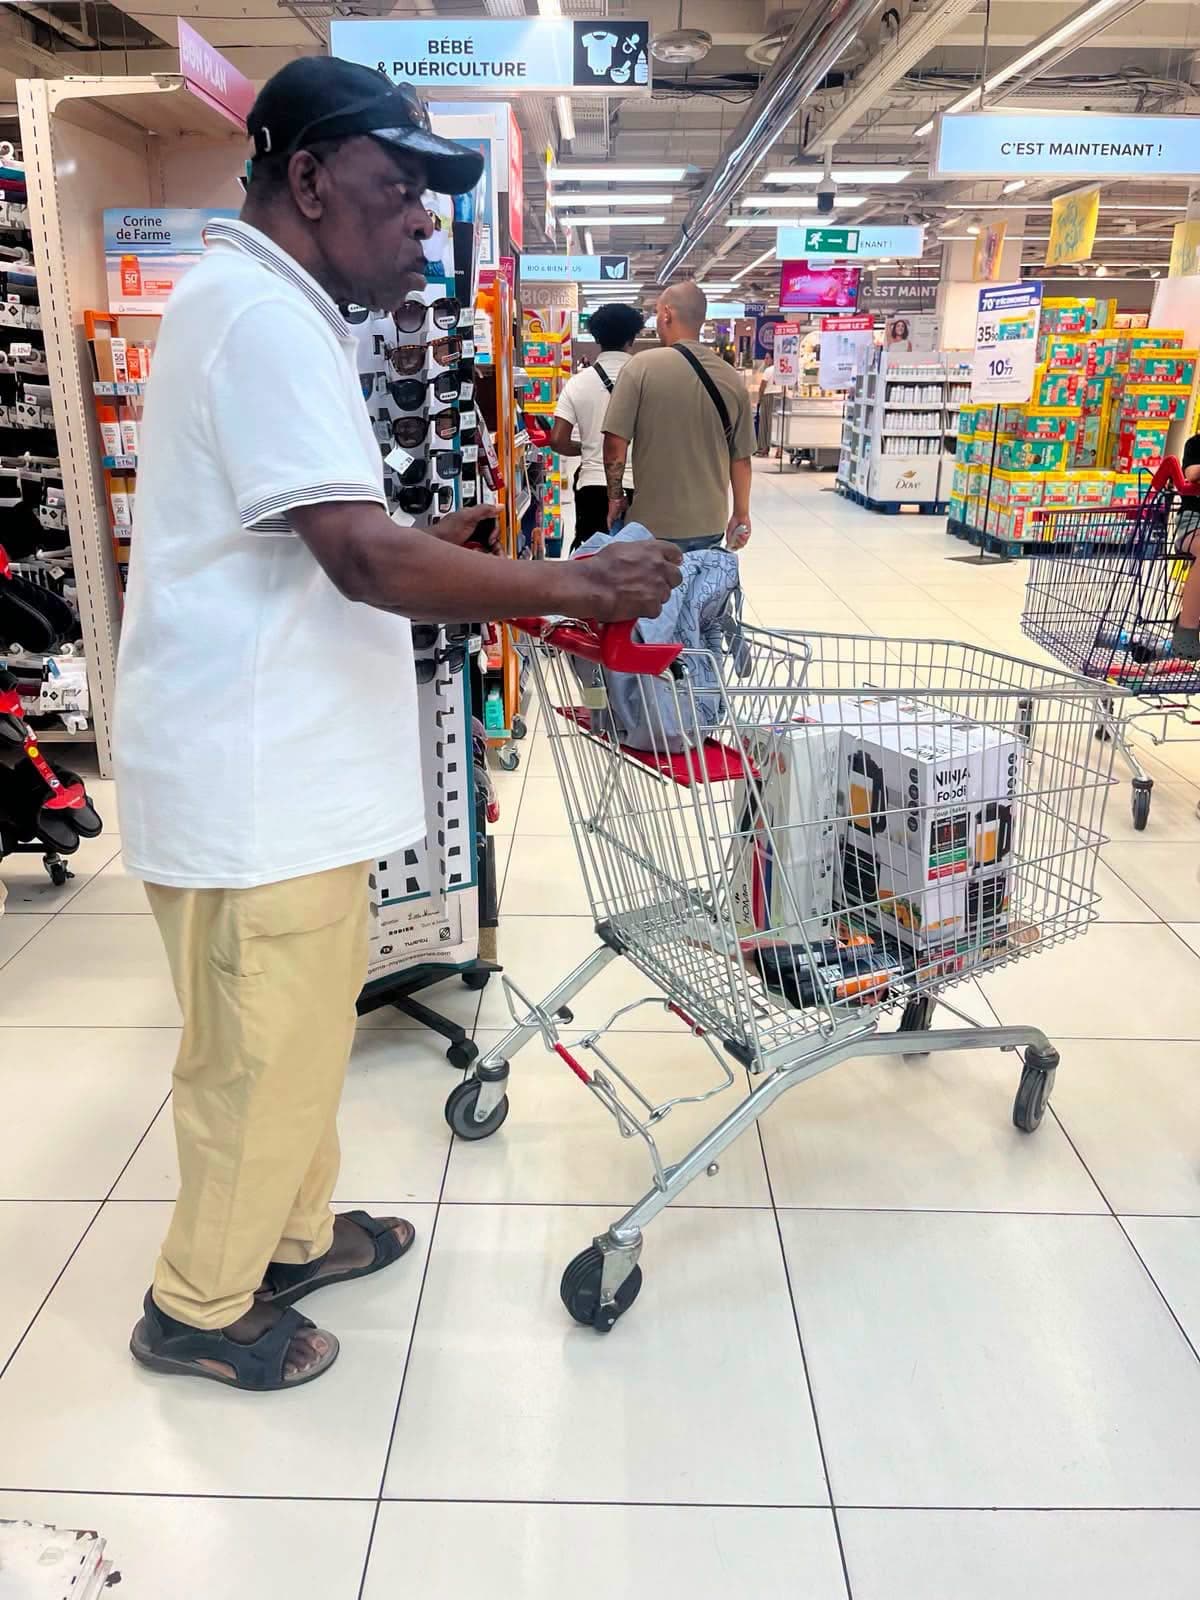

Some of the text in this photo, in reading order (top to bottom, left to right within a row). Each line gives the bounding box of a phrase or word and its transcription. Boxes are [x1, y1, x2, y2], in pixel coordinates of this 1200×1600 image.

[428, 36, 474, 55] BÉBÉ
[392, 57, 528, 77] PUÉRICULTURE
[1001, 142, 1163, 157] C'EST MAINTENANT !
[123, 215, 163, 227] Corine
[116, 228, 171, 240] de Farme
